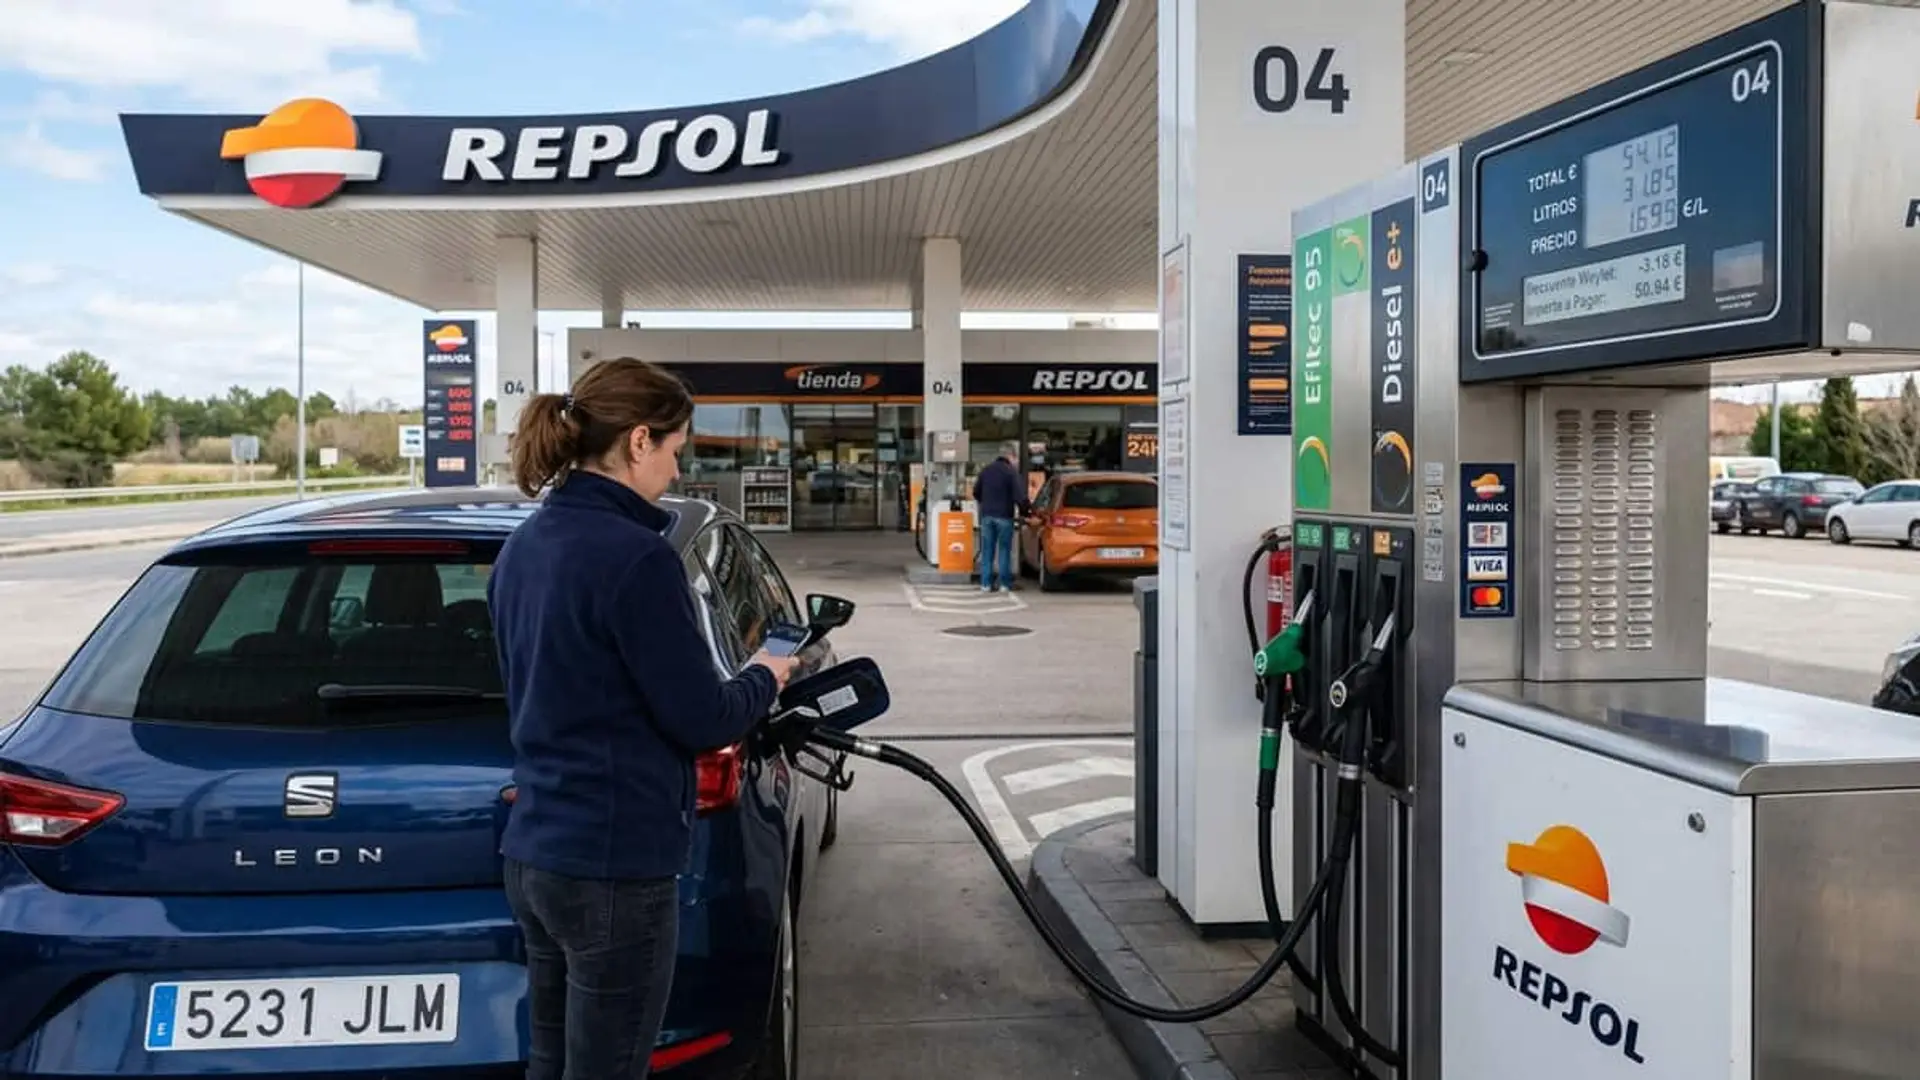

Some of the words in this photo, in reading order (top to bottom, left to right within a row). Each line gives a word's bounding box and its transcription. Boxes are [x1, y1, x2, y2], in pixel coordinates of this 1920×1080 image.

[1252, 45, 1350, 115] 04
[1731, 60, 1771, 102] 04
[442, 109, 779, 181] REPSOL
[1424, 169, 1447, 202] 04
[1527, 173, 1567, 193] TOTAL
[1568, 164, 1578, 180] €
[1531, 230, 1577, 255] PRECIO
[1683, 197, 1709, 218] €/L
[1533, 197, 1577, 224] LITROS
[1387, 221, 1403, 270] e+
[1673, 251, 1683, 267] €
[1305, 246, 1323, 292] 95
[1673, 275, 1683, 292] €
[1382, 285, 1402, 404] Diesel
[505, 381, 525, 395] 04
[797, 371, 862, 389] tienda
[933, 382, 953, 395] 04
[1032, 370, 1149, 391] REPSOL
[235, 848, 382, 866] LEON
[157, 1022, 167, 1037] E
[187, 987, 315, 1039] 5231
[344, 983, 445, 1035] JLM
[1493, 945, 1645, 1064] REPSOL
